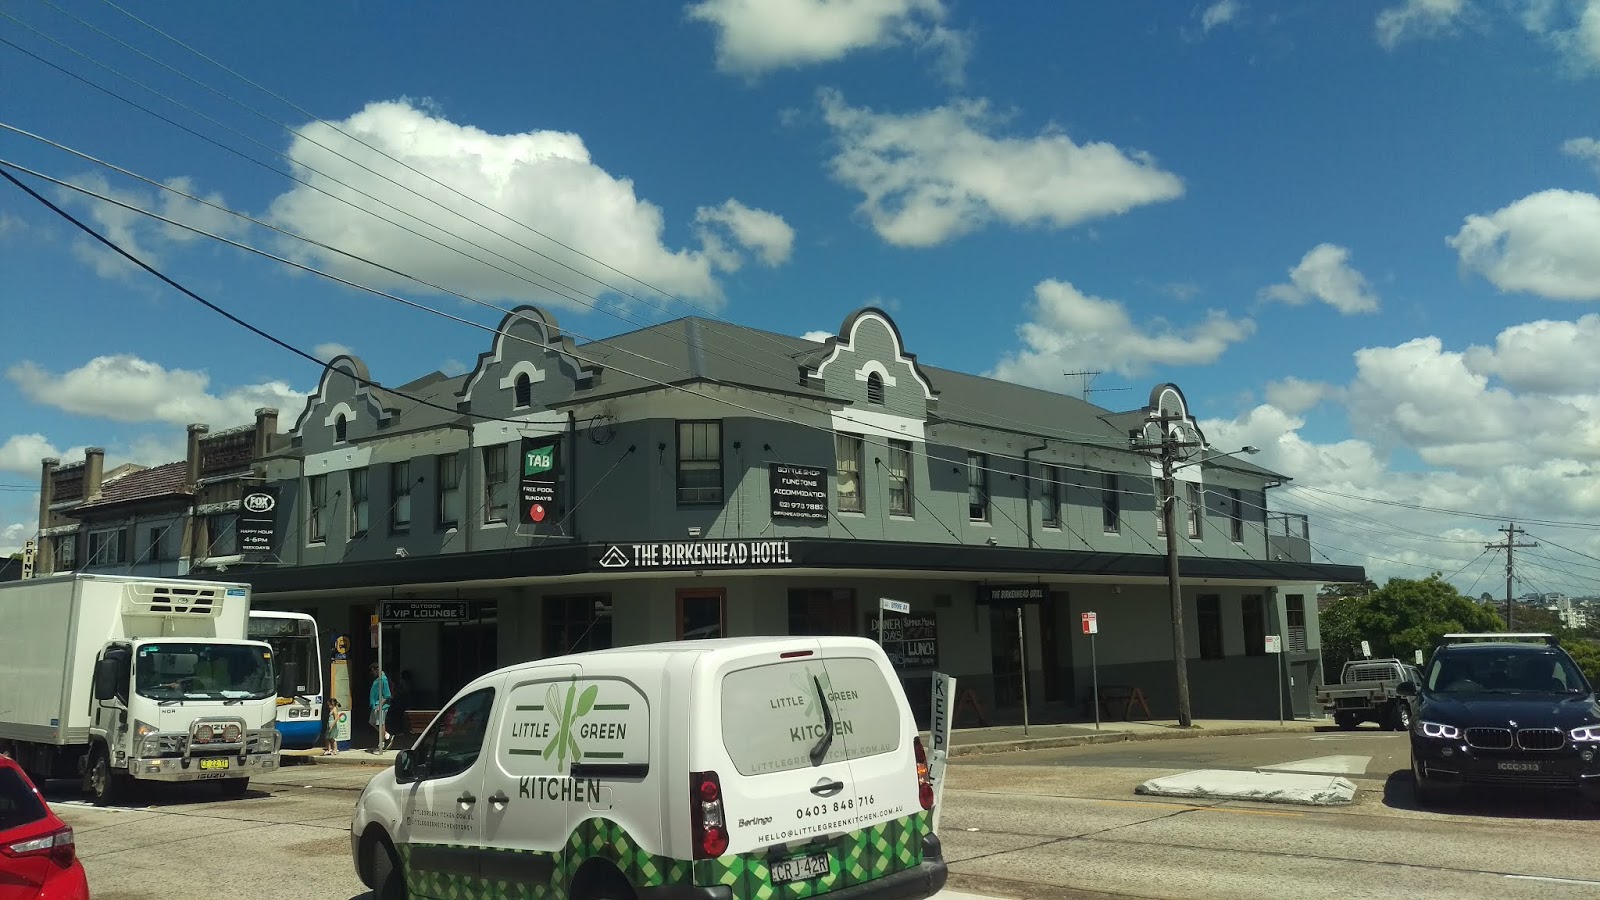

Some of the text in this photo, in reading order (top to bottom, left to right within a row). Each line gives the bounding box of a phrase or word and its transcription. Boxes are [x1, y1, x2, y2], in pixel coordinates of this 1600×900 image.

[528, 453, 550, 468] TAB
[777, 467, 802, 475] BOTTLE
[250, 496, 269, 505] FOX
[773, 488, 827, 498] ACCOMMODATION
[633, 541, 792, 566] THE BIRKENHEAD HOTEL
[393, 609, 457, 618] VIP LOUNGE
[908, 642, 935, 656] LUNCH
[770, 690, 859, 709] LITTLE GREEN
[934, 678, 944, 750] KEEP
[512, 722, 627, 739] LITTLE GREEN
[789, 720, 853, 742] KITCEN
[519, 776, 600, 803] KITCHEN
[796, 795, 875, 819] 0403 848 716
[737, 815, 773, 828] Berlingo
[758, 805, 904, 843] HELLO@LITTLEGREENKITCHEN.COM.AU
